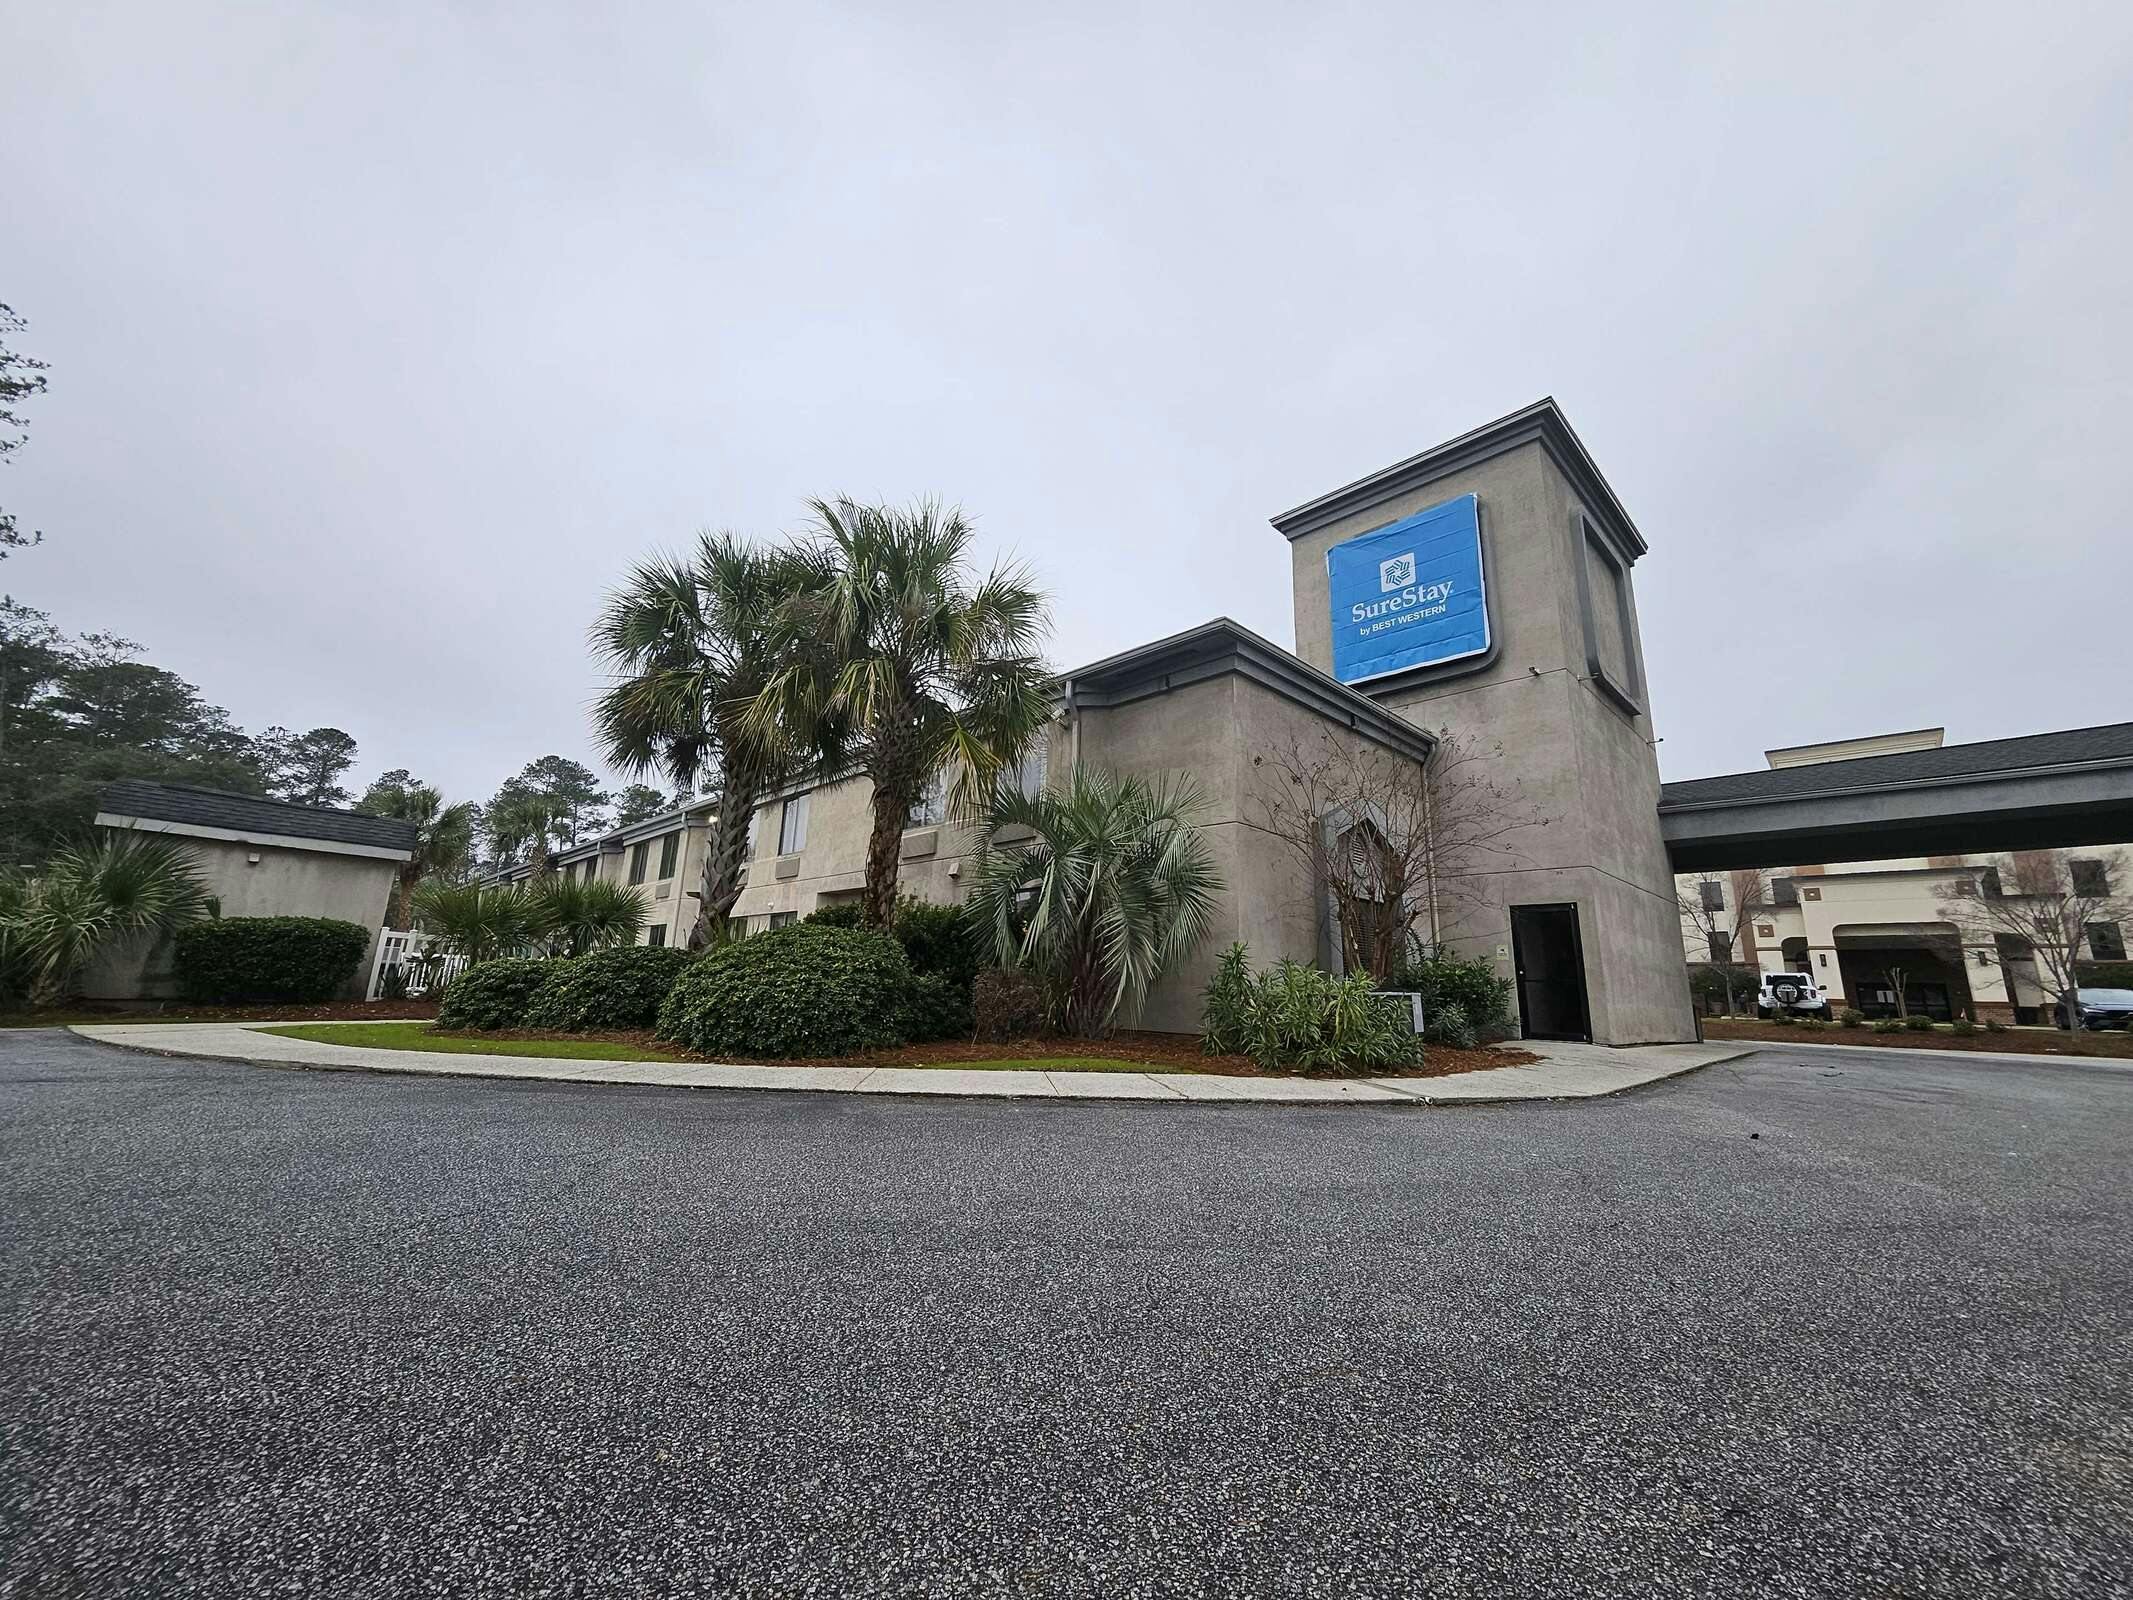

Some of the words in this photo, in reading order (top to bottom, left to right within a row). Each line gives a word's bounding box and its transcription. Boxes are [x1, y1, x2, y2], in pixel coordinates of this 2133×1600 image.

[1352, 581, 1454, 622] SureStay
[1360, 627, 1371, 636] by
[1372, 618, 1397, 632] BEST
[1398, 605, 1446, 624] WESTERN
